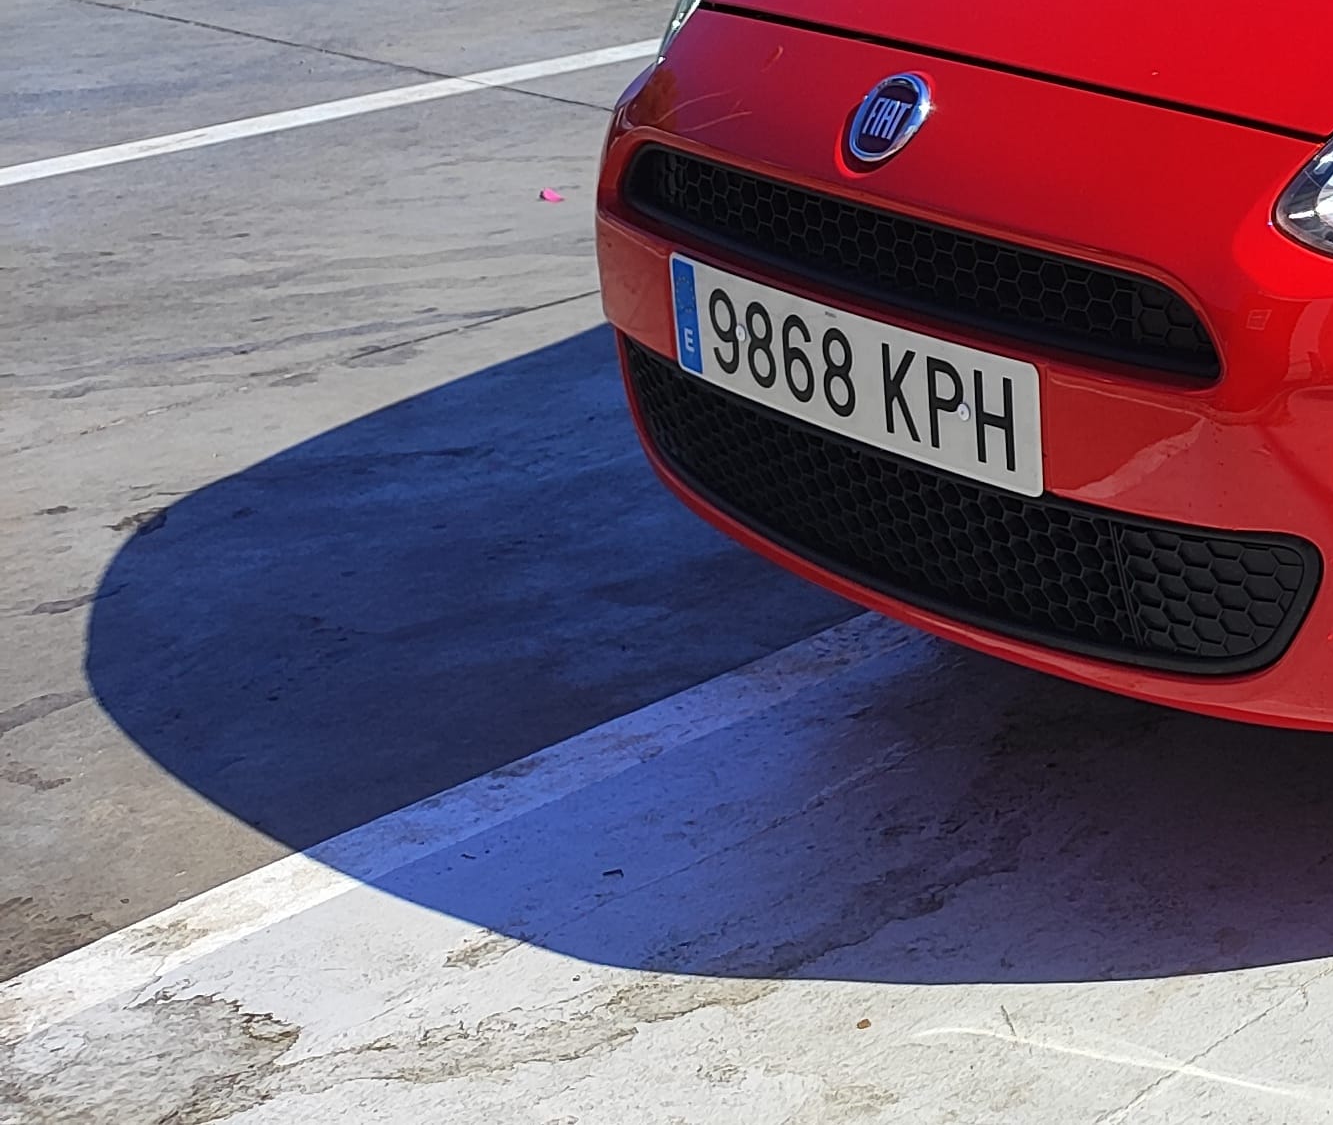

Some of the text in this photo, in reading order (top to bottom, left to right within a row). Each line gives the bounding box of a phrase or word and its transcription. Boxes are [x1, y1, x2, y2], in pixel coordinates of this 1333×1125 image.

[862, 97, 913, 140] FIAT
[684, 327, 695, 353] E
[708, 288, 1016, 472] 9868 KPH
